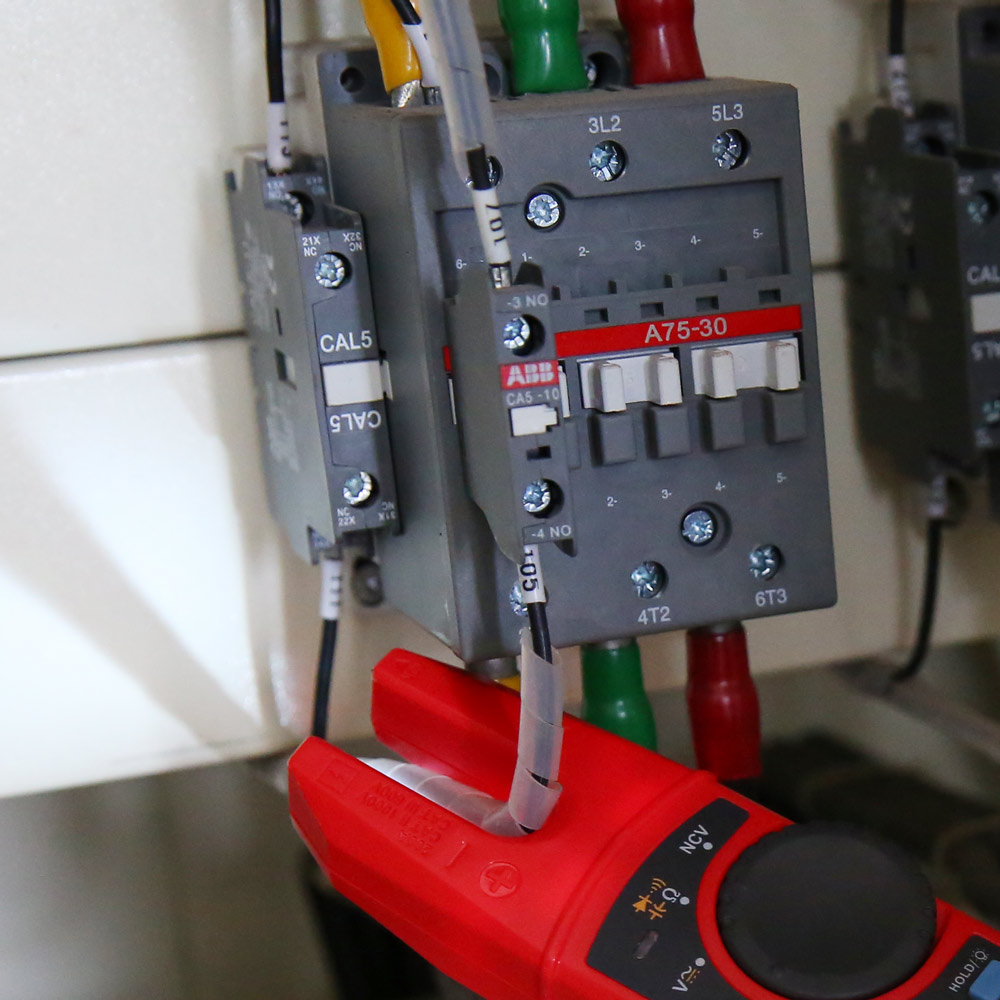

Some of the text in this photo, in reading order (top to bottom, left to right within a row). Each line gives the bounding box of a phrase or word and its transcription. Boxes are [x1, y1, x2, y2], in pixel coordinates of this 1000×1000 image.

[711, 103, 744, 123] 5L3
[588, 115, 622, 134] 3L2
[301, 235, 321, 247] 21X
[303, 246, 318, 257] NC
[526, 293, 549, 307] NO
[643, 316, 728, 344] A75-30
[319, 329, 373, 353] CAL5
[506, 360, 556, 387] ABB
[506, 391, 533, 406] CA5
[329, 410, 382, 434] CAL5
[531, 524, 572, 539] -4 NO
[755, 588, 787, 608] 6T3
[637, 606, 671, 625] 4T2
[679, 824, 710, 854] NCV
